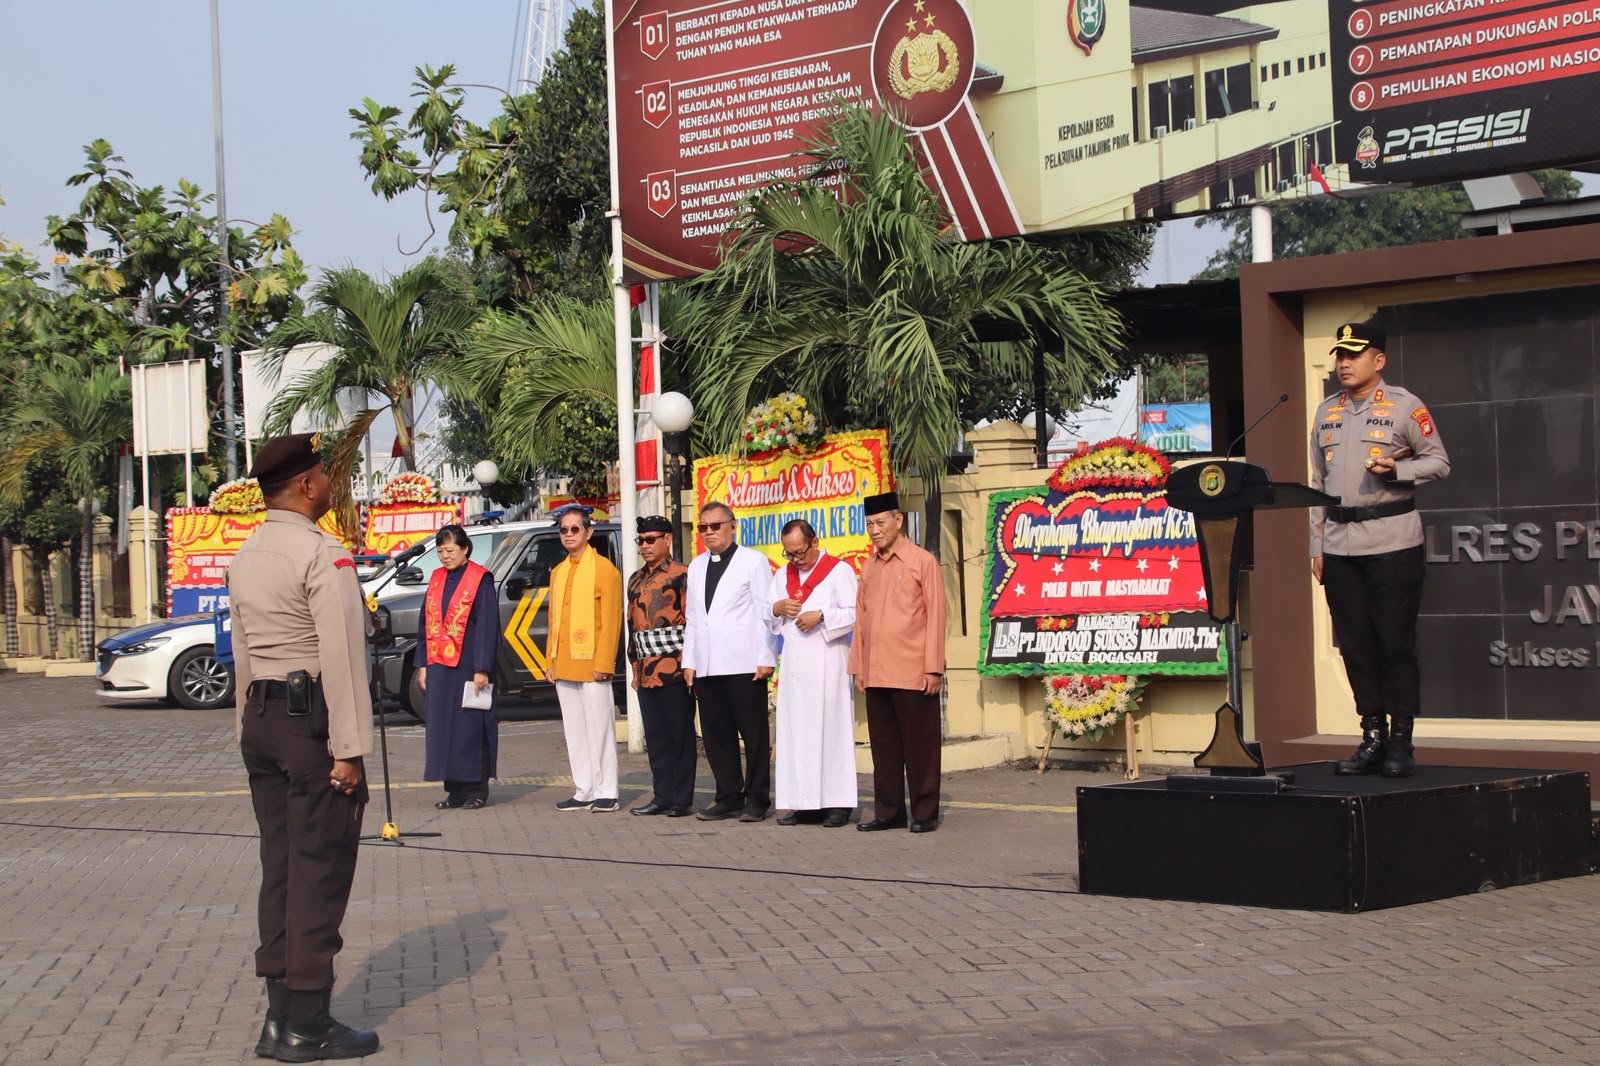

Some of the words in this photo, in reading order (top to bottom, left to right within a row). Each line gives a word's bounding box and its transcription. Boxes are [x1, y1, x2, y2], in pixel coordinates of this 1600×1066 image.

[675, 14, 718, 32] BERBAKTI
[720, 5, 756, 22] KEPADA
[758, 0, 783, 13] NUSA
[675, 30, 713, 47] DENGAN
[714, 21, 745, 38] PENUH
[746, 9, 805, 31] KETAKWAAN
[806, 0, 858, 18] TERHADAP
[1355, 19, 1365, 31] 6
[646, 24, 663, 45] 01
[676, 44, 707, 61] TUHAN
[708, 38, 733, 54] YANG
[735, 33, 762, 48] MAHA
[763, 29, 782, 43] ESA
[1380, 32, 1472, 61] PEMANTAPAN
[1476, 16, 1558, 44] DUKUNGAN
[1356, 54, 1365, 67] 7
[678, 79, 737, 100] MENJUNJUNG
[739, 71, 769, 88] TINGGI
[771, 60, 831, 81] KEBENARAN,
[1381, 71, 1467, 98] PEMULIHAN
[1471, 57, 1545, 83] EKONOMI
[647, 90, 666, 113] 02
[679, 97, 725, 115] KEADILAN,
[726, 92, 745, 105] DAN
[748, 78, 815, 101] KEMANUSIAAN
[817, 71, 851, 88] DALAM
[1357, 90, 1366, 103] 8
[679, 108, 734, 130] MENEGAKAN
[736, 102, 768, 119] HUKUM
[770, 95, 810, 112] NEGARA
[1095, 114, 1115, 132] RESOR
[679, 127, 722, 144] REPUBLIK
[723, 117, 772, 136] INDONESIA
[775, 113, 800, 126] YANG
[1383, 108, 1531, 154] PRESISI
[680, 141, 729, 158] PANCASILA
[731, 136, 749, 149] DAN
[752, 132, 771, 145] UUD
[773, 128, 794, 141] 1945
[1045, 146, 1083, 170] PELABUHAN
[1084, 138, 1111, 158] TANJUNG
[1112, 132, 1130, 150] PRIOK
[652, 180, 671, 201] 03
[680, 177, 736, 195] SENANTIASA
[681, 200, 699, 210] DAN
[1366, 419, 1394, 428] POLRI
[725, 469, 785, 507] Selamat
[800, 461, 855, 498] Sukses
[830, 505, 846, 537] KE
[1081, 505, 1163, 557] Bhayangkara
[1070, 580, 1102, 597] UNTUK
[1105, 579, 1171, 597] MASYARAKAT
[198, 595, 217, 612] PT
[1077, 615, 1140, 630] MANAGEMENT
[1094, 629, 1139, 651] SUKSES
[1488, 640, 1591, 667] Sukses
[1044, 651, 1083, 664] DIVISI
[1088, 651, 1158, 664] BOGASARI
